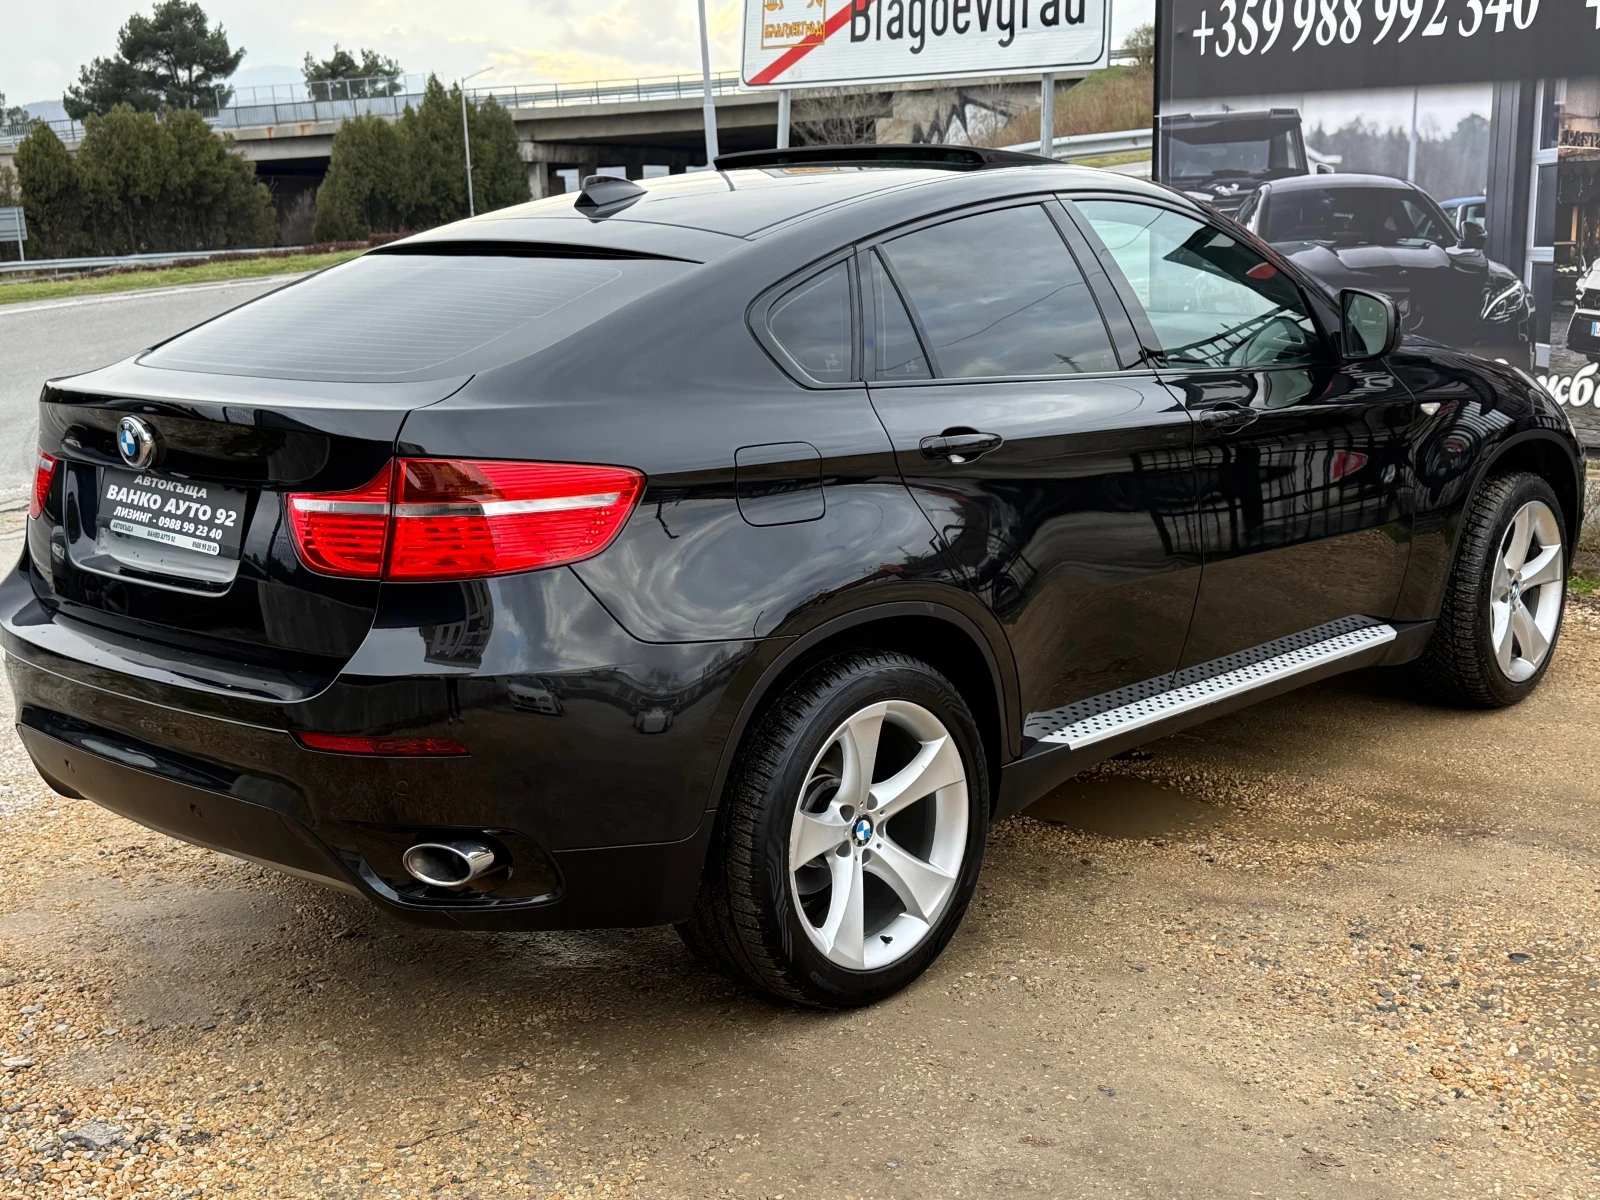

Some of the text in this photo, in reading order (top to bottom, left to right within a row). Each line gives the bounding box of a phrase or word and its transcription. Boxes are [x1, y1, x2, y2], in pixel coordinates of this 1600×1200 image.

[1193, 0, 1284, 57] +359
[1291, 0, 1363, 52] 988
[1373, 0, 1448, 45] 992
[106, 484, 237, 527] ВАНКО АУТО 92
[134, 474, 207, 498] АВТОКЪЩА
[113, 506, 152, 523] ЛИЗИНГ
[158, 516, 181, 531] 0988
[182, 522, 195, 534] 99
[196, 525, 208, 537] 23
[209, 528, 223, 541] 40
